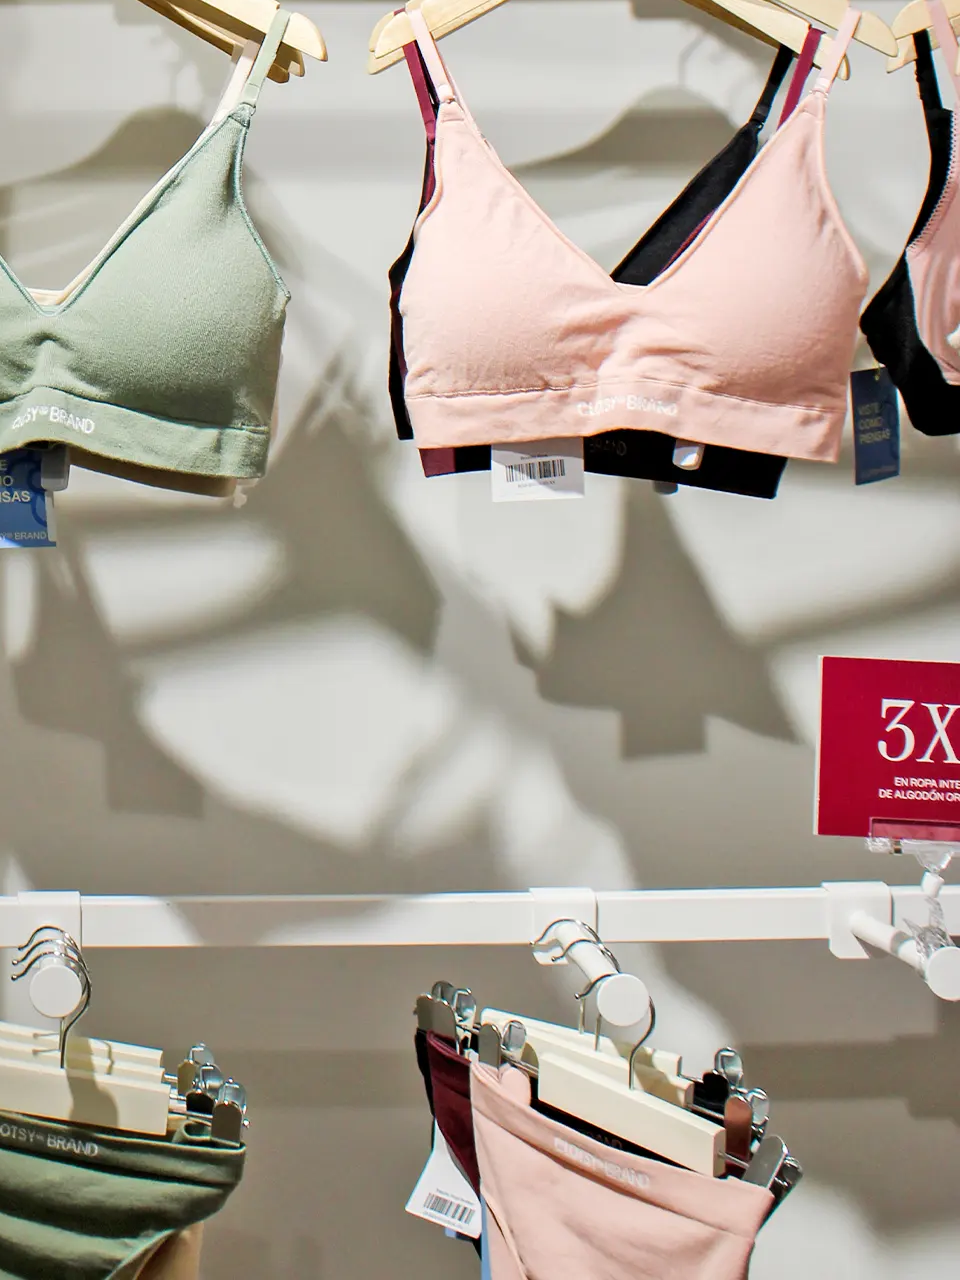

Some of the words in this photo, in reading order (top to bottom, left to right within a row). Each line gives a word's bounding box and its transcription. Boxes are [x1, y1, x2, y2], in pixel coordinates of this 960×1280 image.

[49, 405, 96, 434] BRAND
[14, 531, 48, 541] BRAND
[894, 776, 909, 788] EN
[909, 777, 939, 789] ROPA
[878, 788, 893, 799] DE
[894, 789, 945, 802] ALGODÓN
[46, 1133, 100, 1157] BRAND
